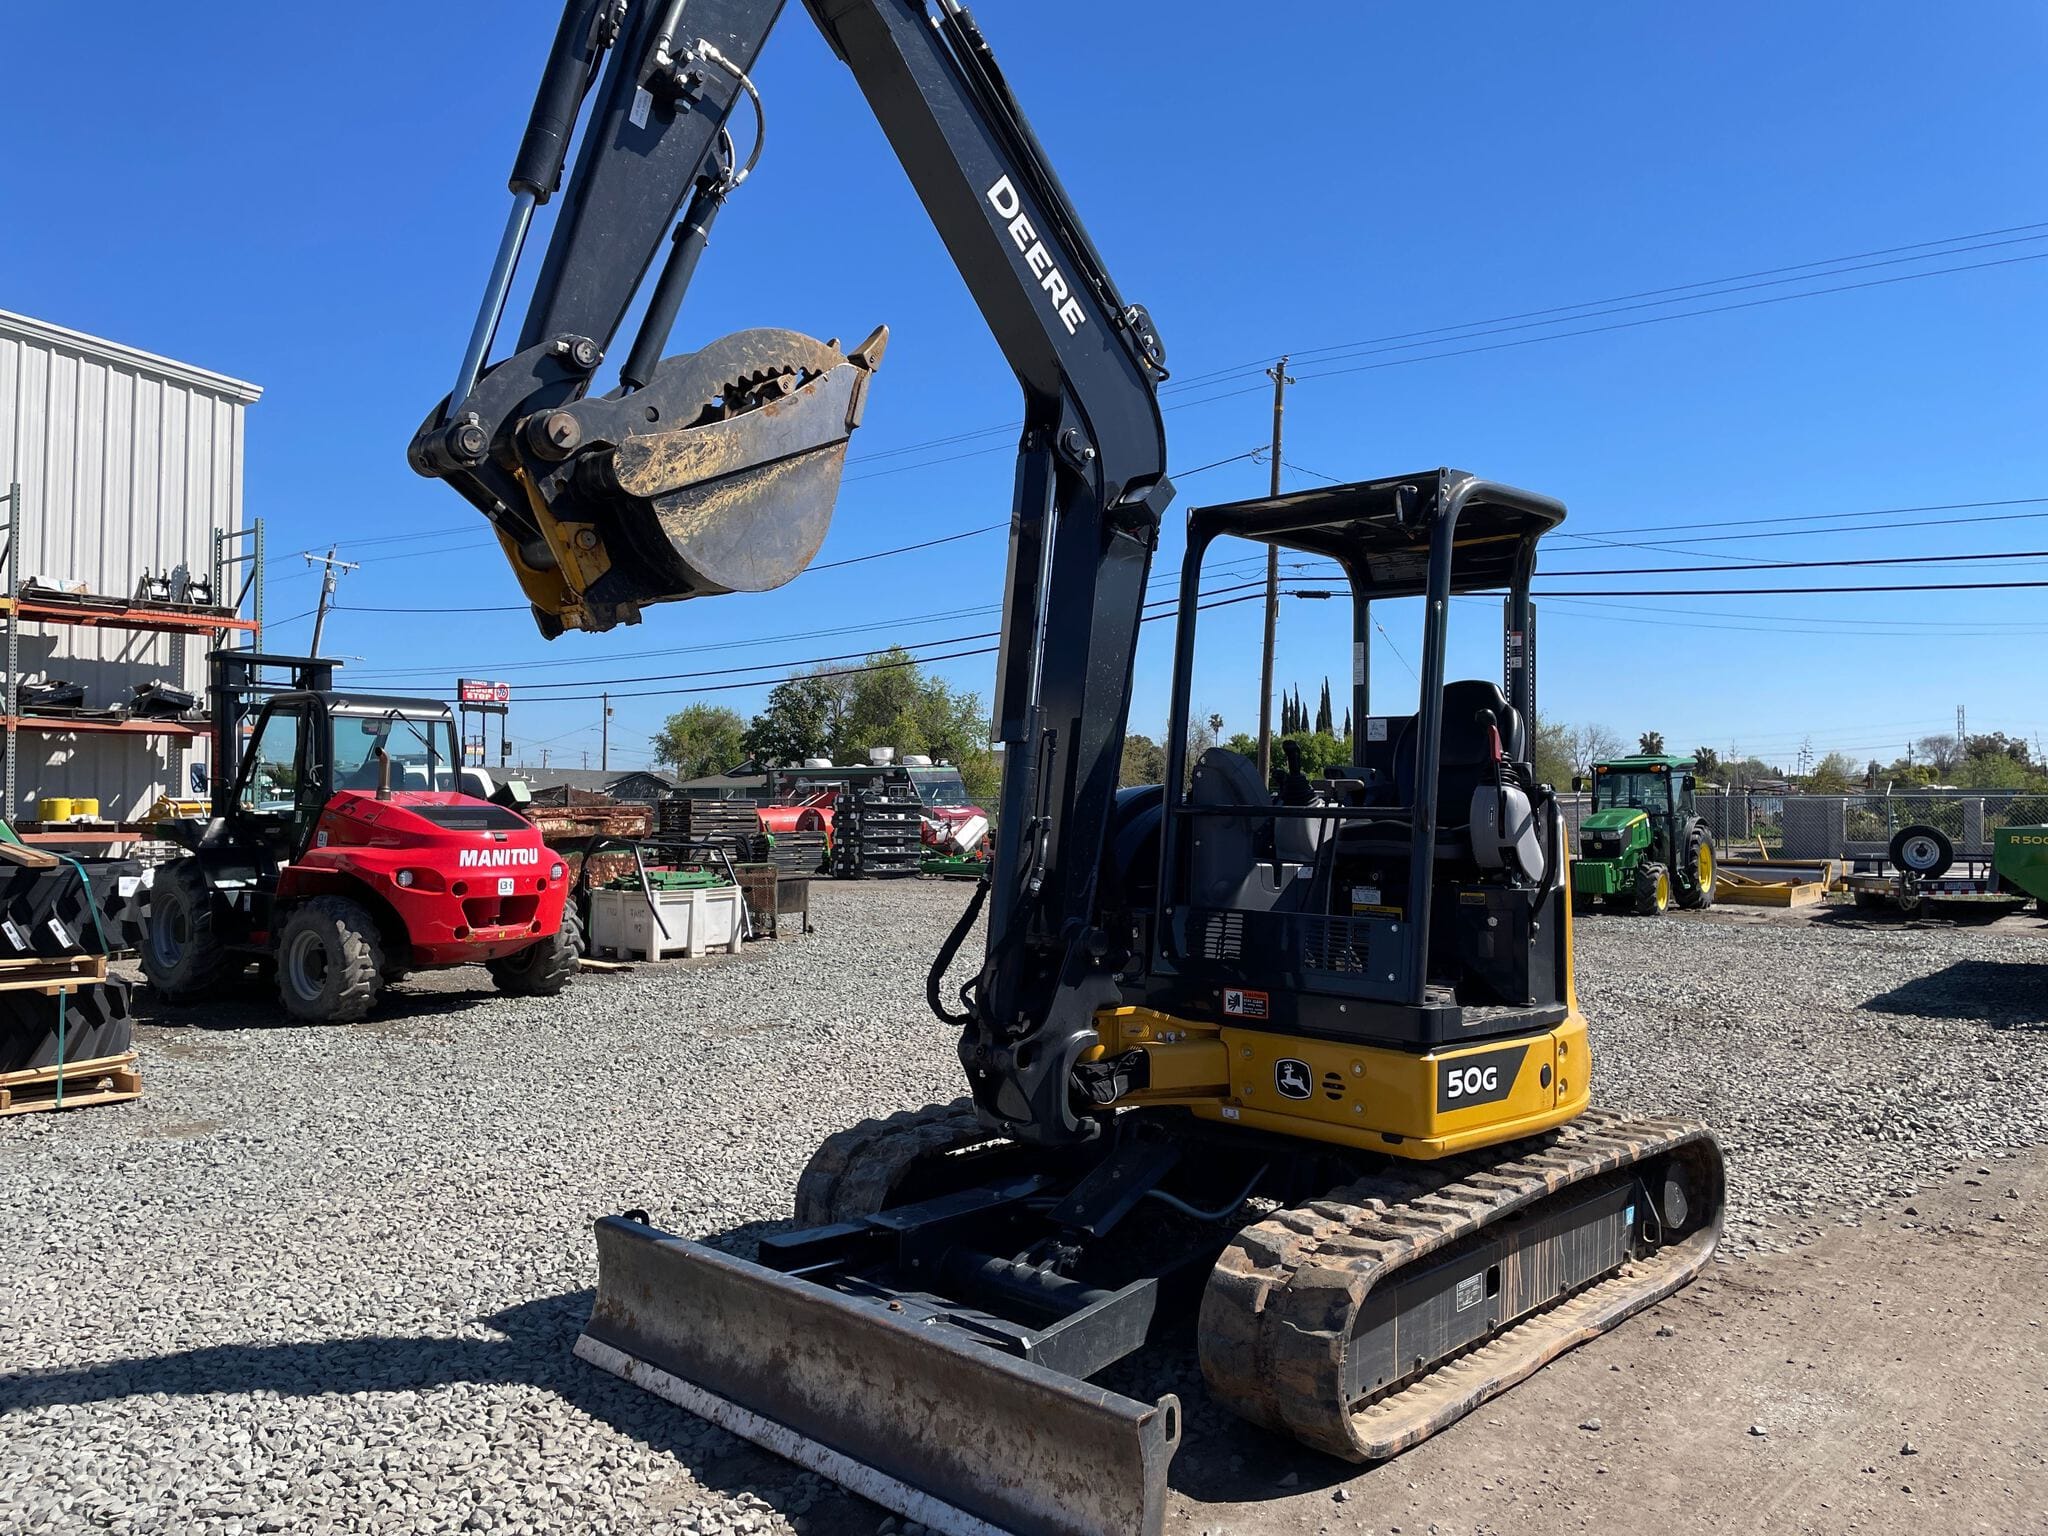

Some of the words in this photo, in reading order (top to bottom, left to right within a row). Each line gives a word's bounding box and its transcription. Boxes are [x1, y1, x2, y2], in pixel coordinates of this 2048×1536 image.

[987, 174, 1086, 336] DEERE
[467, 692, 491, 700] STOP
[497, 688, 507, 698] 76
[459, 848, 538, 867] MANITOU
[1447, 1066, 1497, 1098] 50G
